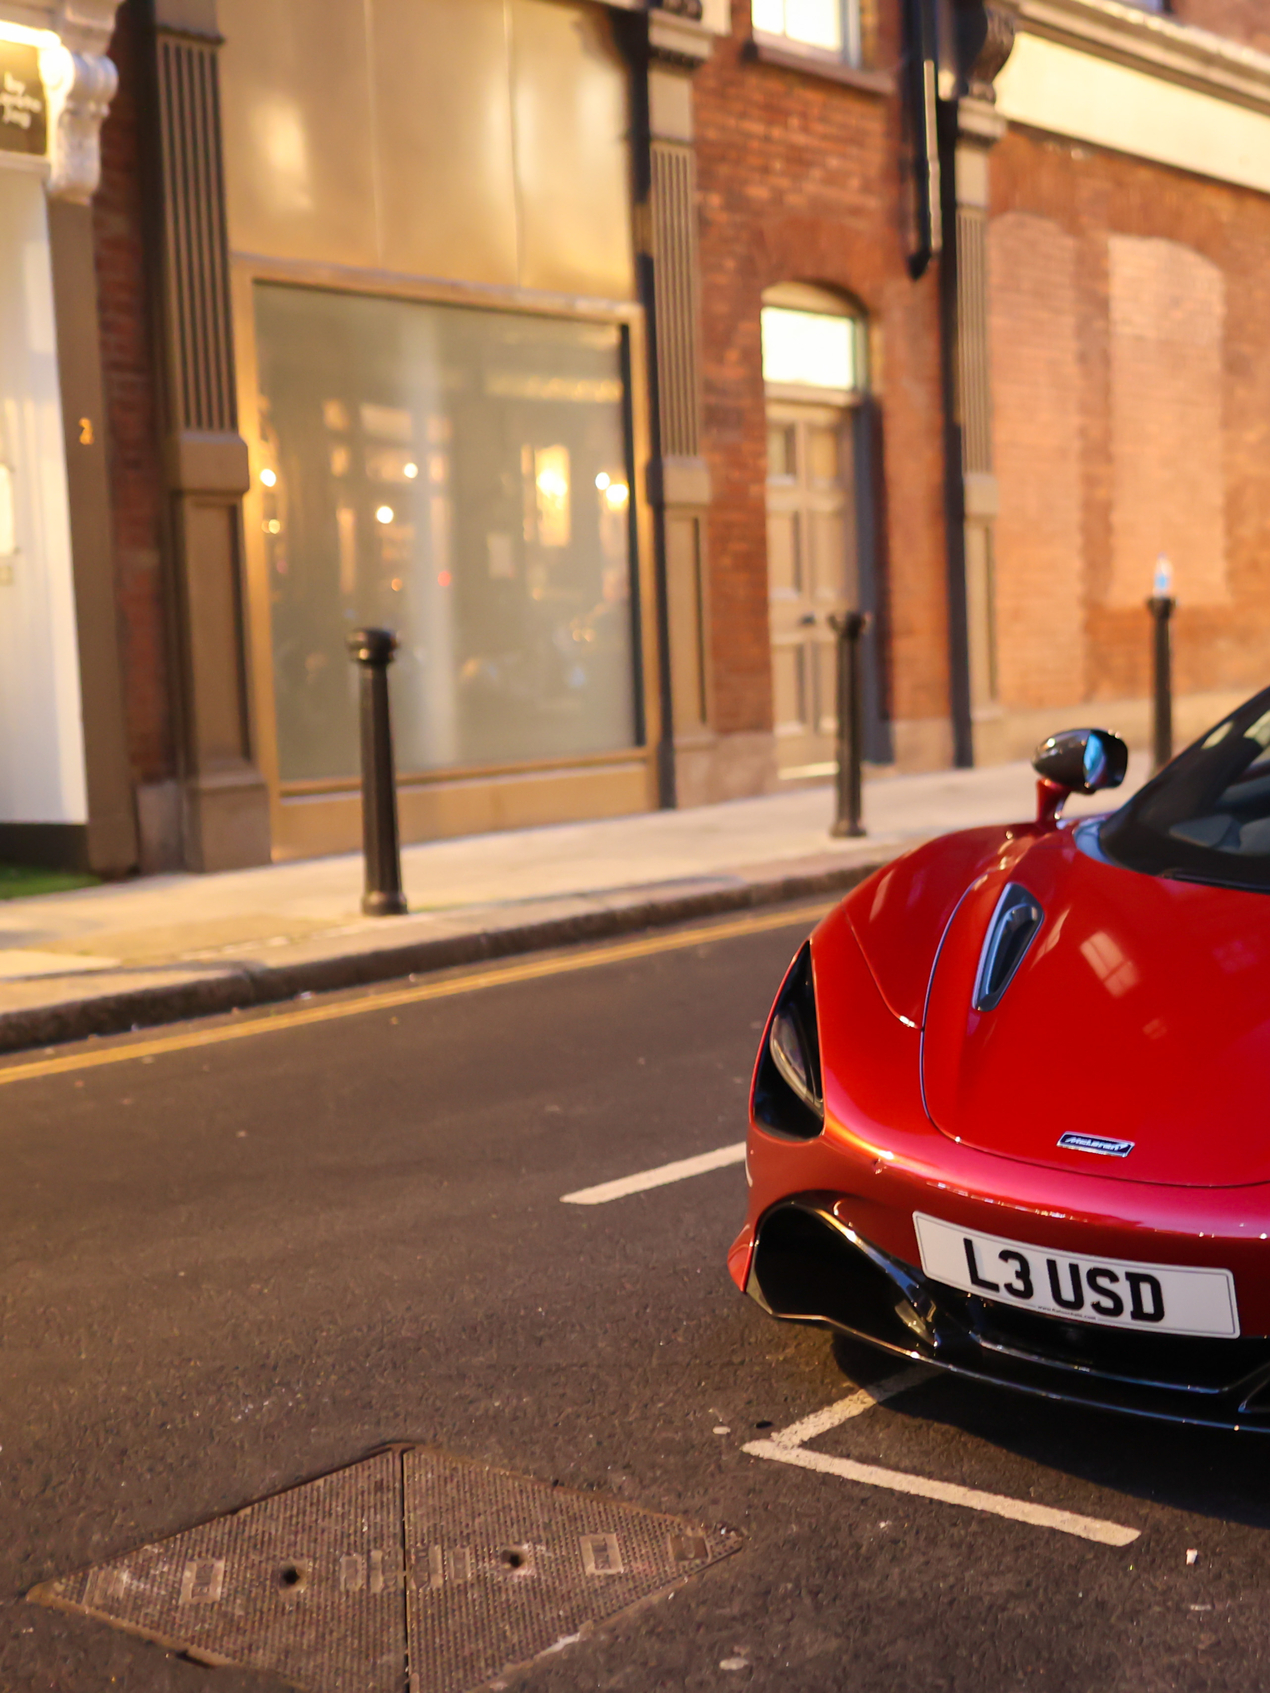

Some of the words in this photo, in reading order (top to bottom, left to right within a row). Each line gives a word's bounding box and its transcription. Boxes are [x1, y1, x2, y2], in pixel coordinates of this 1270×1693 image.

[1065, 1135, 1125, 1151] McLaren
[963, 1237, 1035, 1300] L3
[1046, 1258, 1166, 1323] USD
